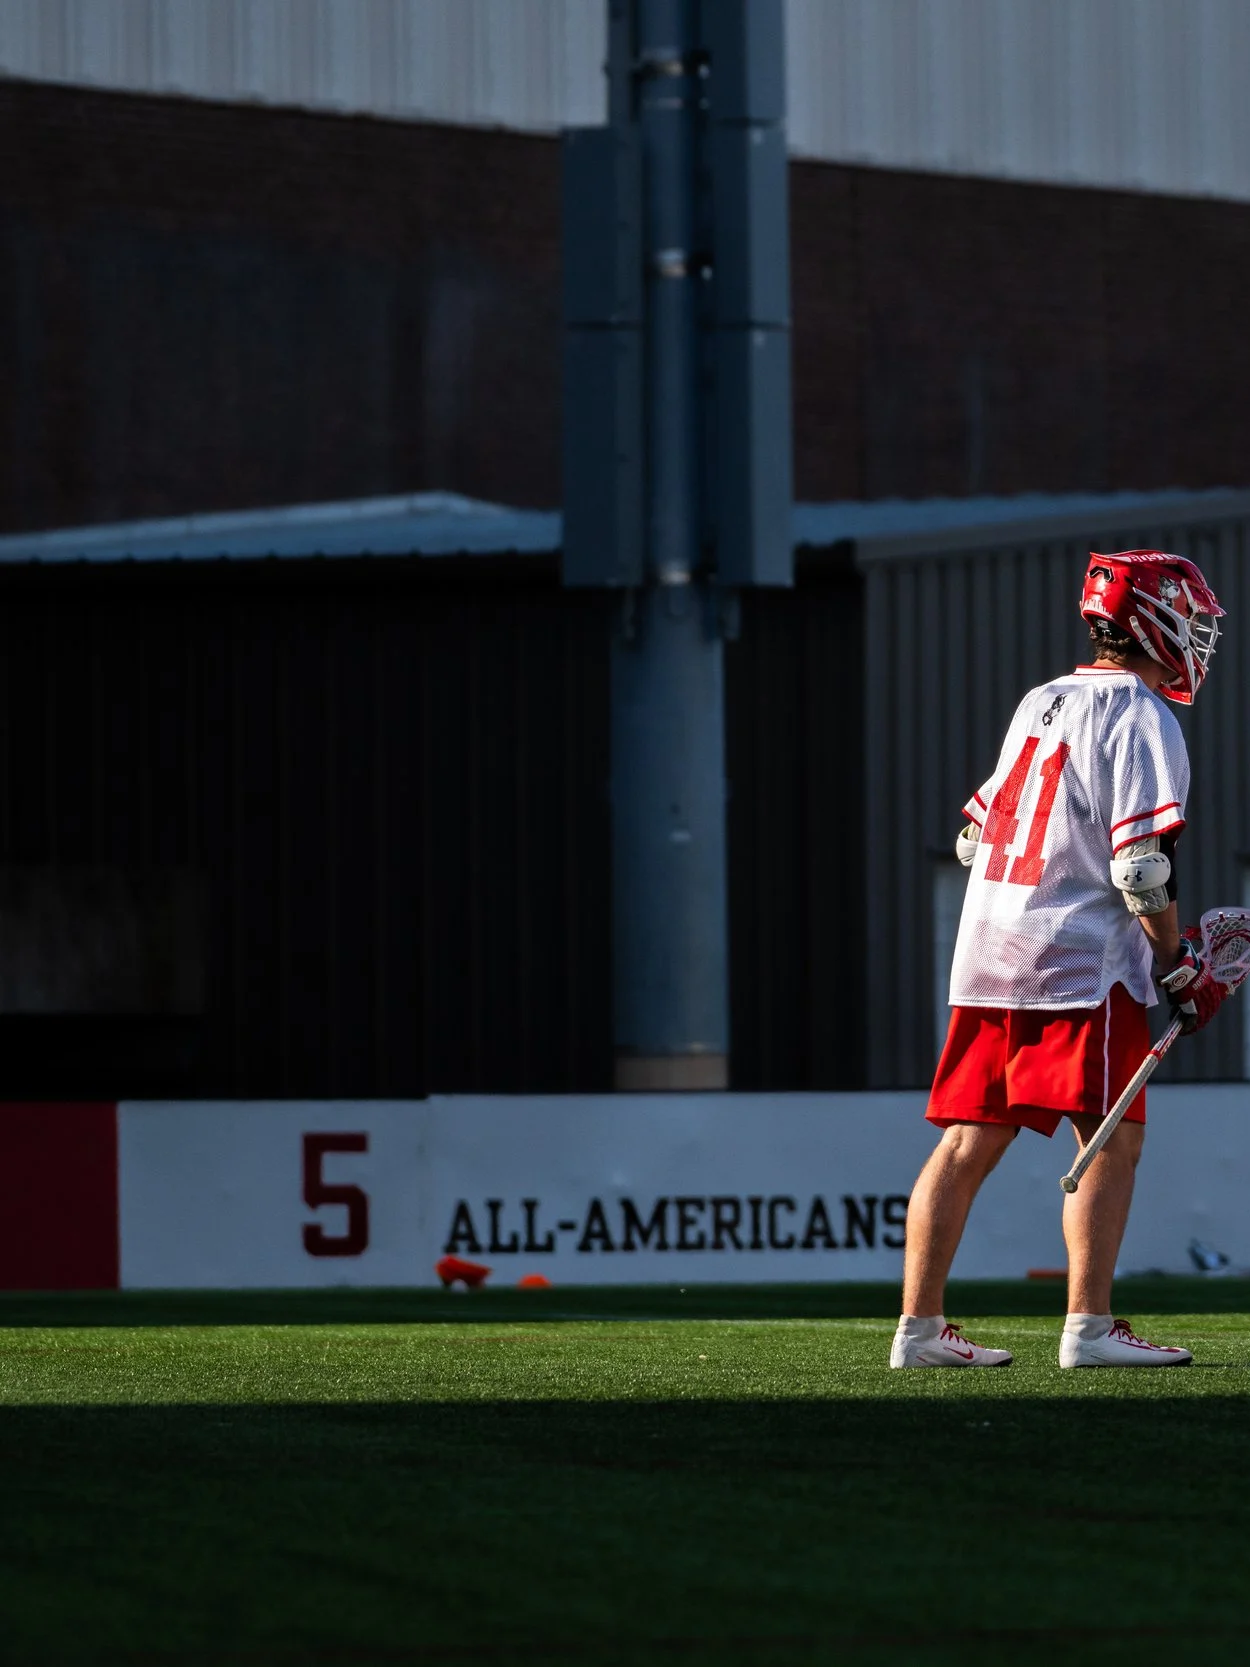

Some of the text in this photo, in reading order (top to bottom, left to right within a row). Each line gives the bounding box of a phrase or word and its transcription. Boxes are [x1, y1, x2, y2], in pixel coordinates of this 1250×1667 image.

[981, 735, 1072, 887] 41
[1192, 967, 1209, 991] BOSTO
[303, 1130, 909, 1258] 5 ALL-AMERICANS
